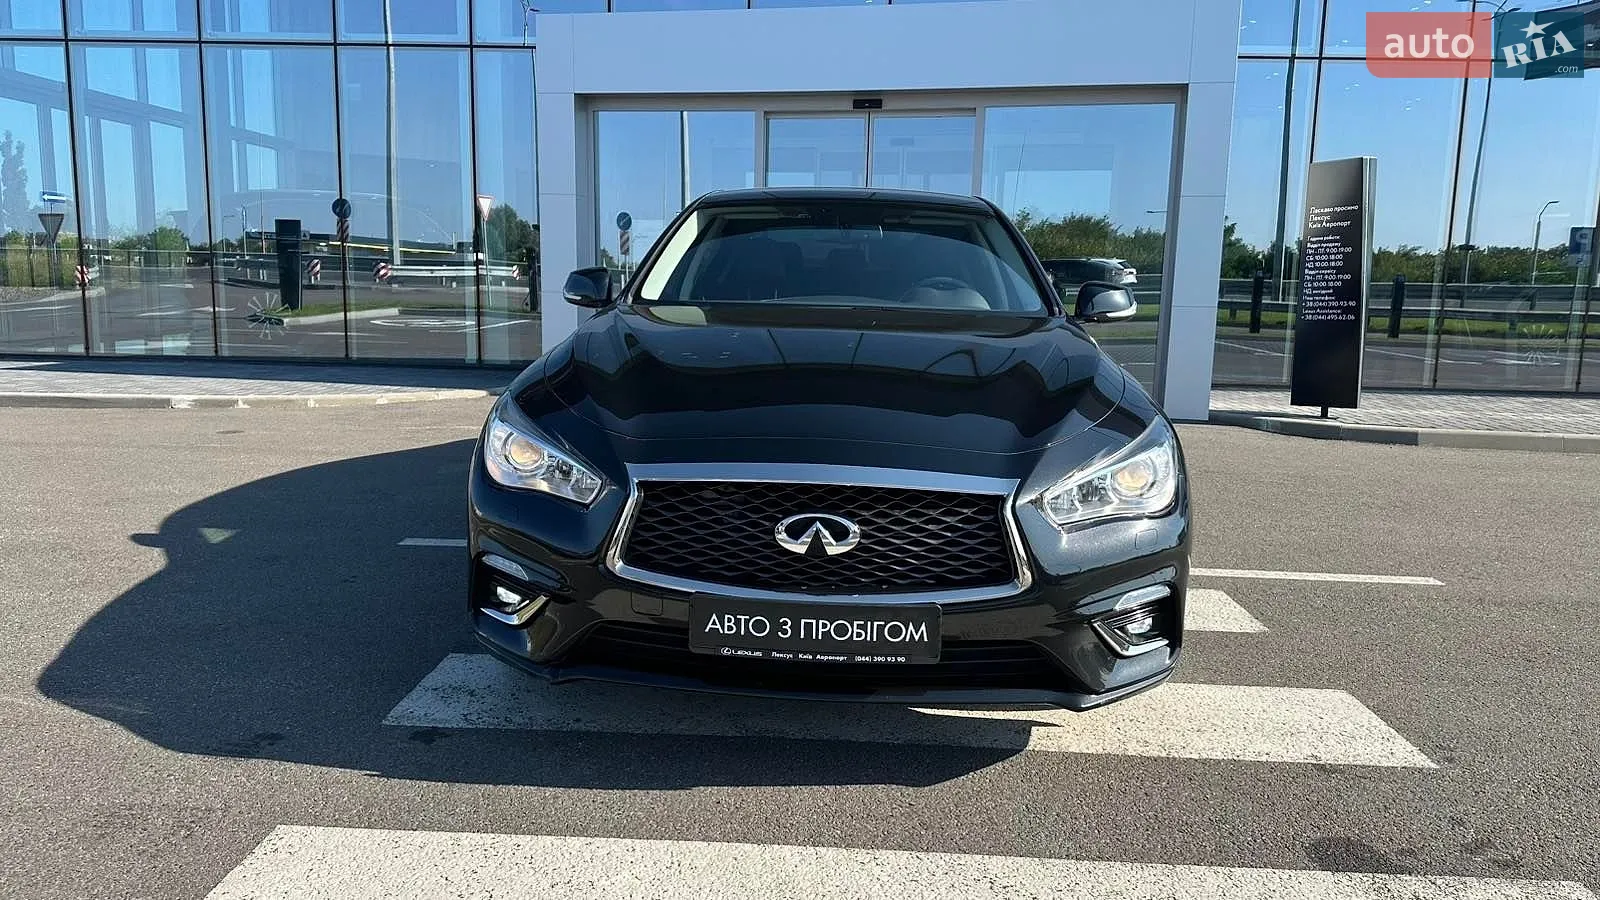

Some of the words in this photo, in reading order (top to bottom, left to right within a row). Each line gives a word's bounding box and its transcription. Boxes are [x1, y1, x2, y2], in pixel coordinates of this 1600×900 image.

[704, 613, 770, 637] АВТО
[800, 618, 929, 642] ПРОБІГОМ
[732, 649, 763, 657] LEXUS
